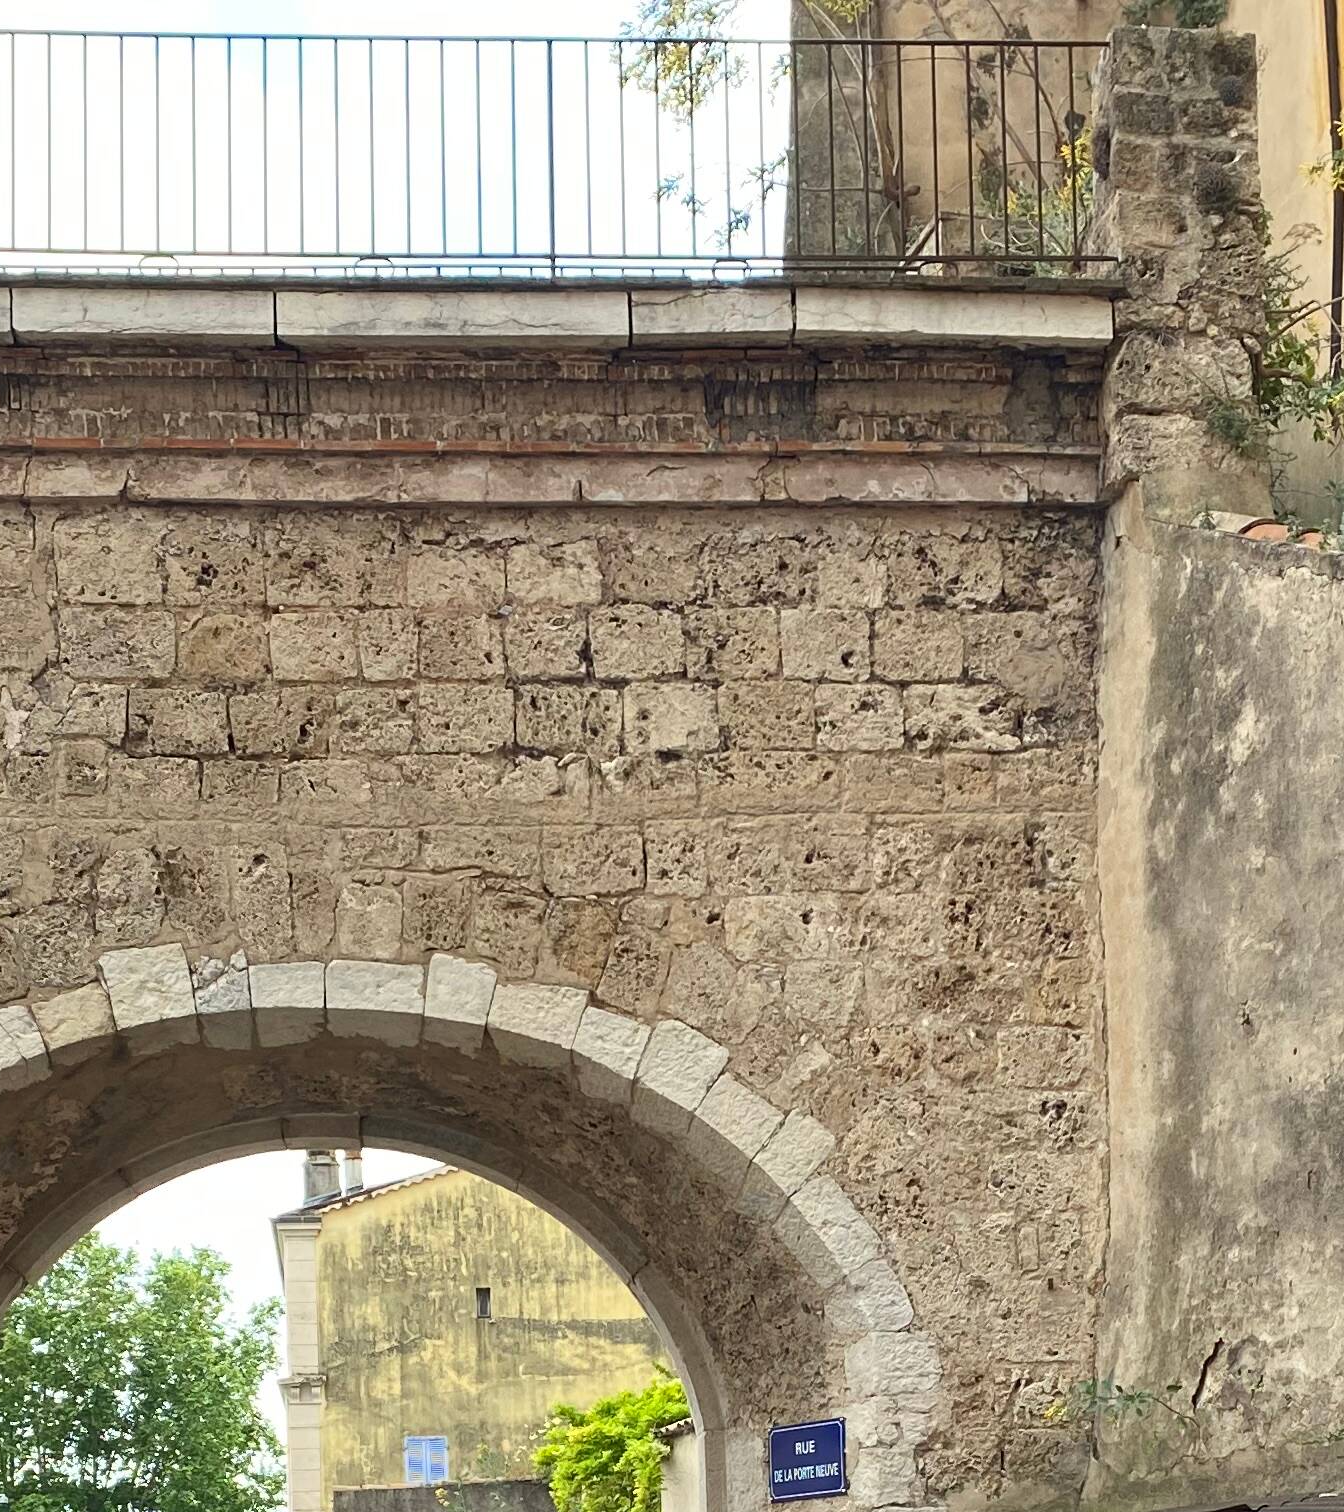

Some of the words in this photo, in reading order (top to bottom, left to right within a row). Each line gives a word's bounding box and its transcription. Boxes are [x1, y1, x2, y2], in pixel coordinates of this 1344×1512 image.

[795, 1440, 815, 1455] RUE
[774, 1470, 783, 1482] DE
[784, 1469, 793, 1481] LA
[794, 1466, 815, 1480] PORTE
[816, 1463, 839, 1477] NEUVE
